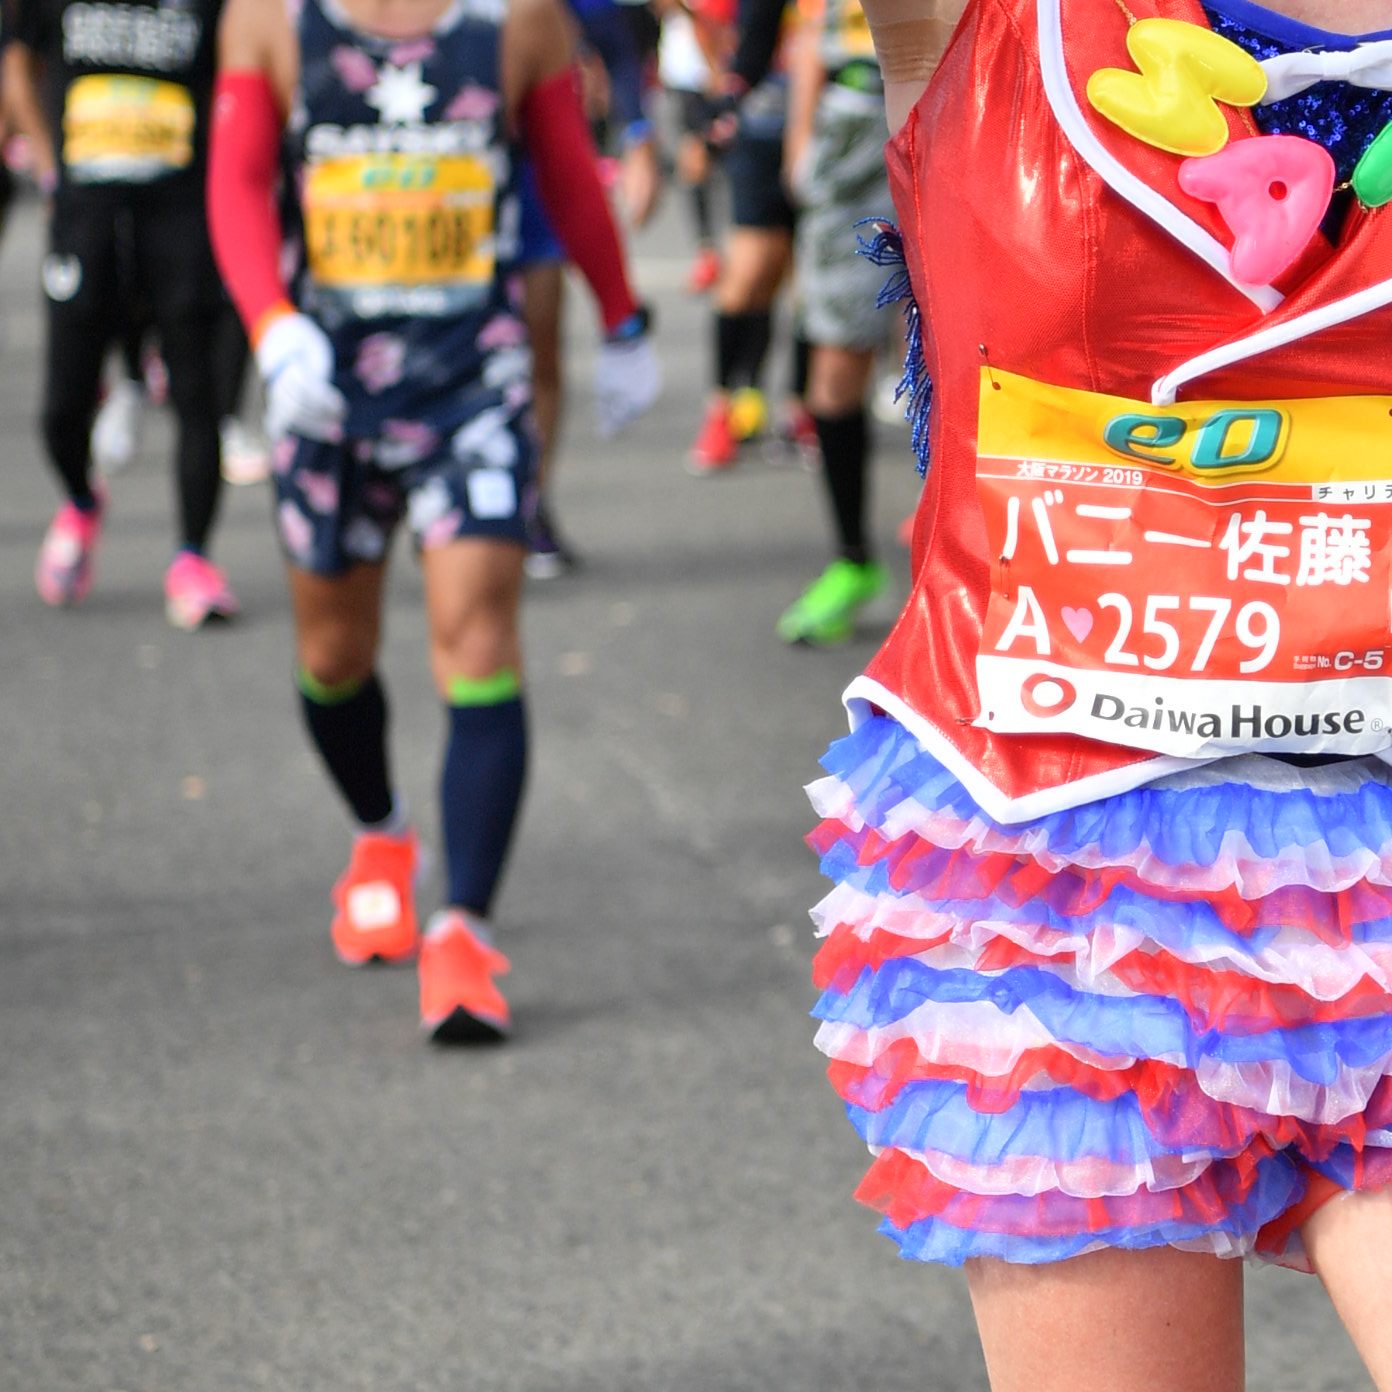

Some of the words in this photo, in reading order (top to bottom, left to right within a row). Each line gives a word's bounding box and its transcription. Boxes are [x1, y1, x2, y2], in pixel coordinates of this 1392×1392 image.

[1016, 460, 1098, 482] 大阪マラソン
[1102, 468, 1143, 486] 2019
[1001, 490, 1372, 587] バニー佐藤
[995, 585, 1052, 656] A
[1098, 592, 1281, 675] 2579
[1334, 650, 1385, 671] C-5
